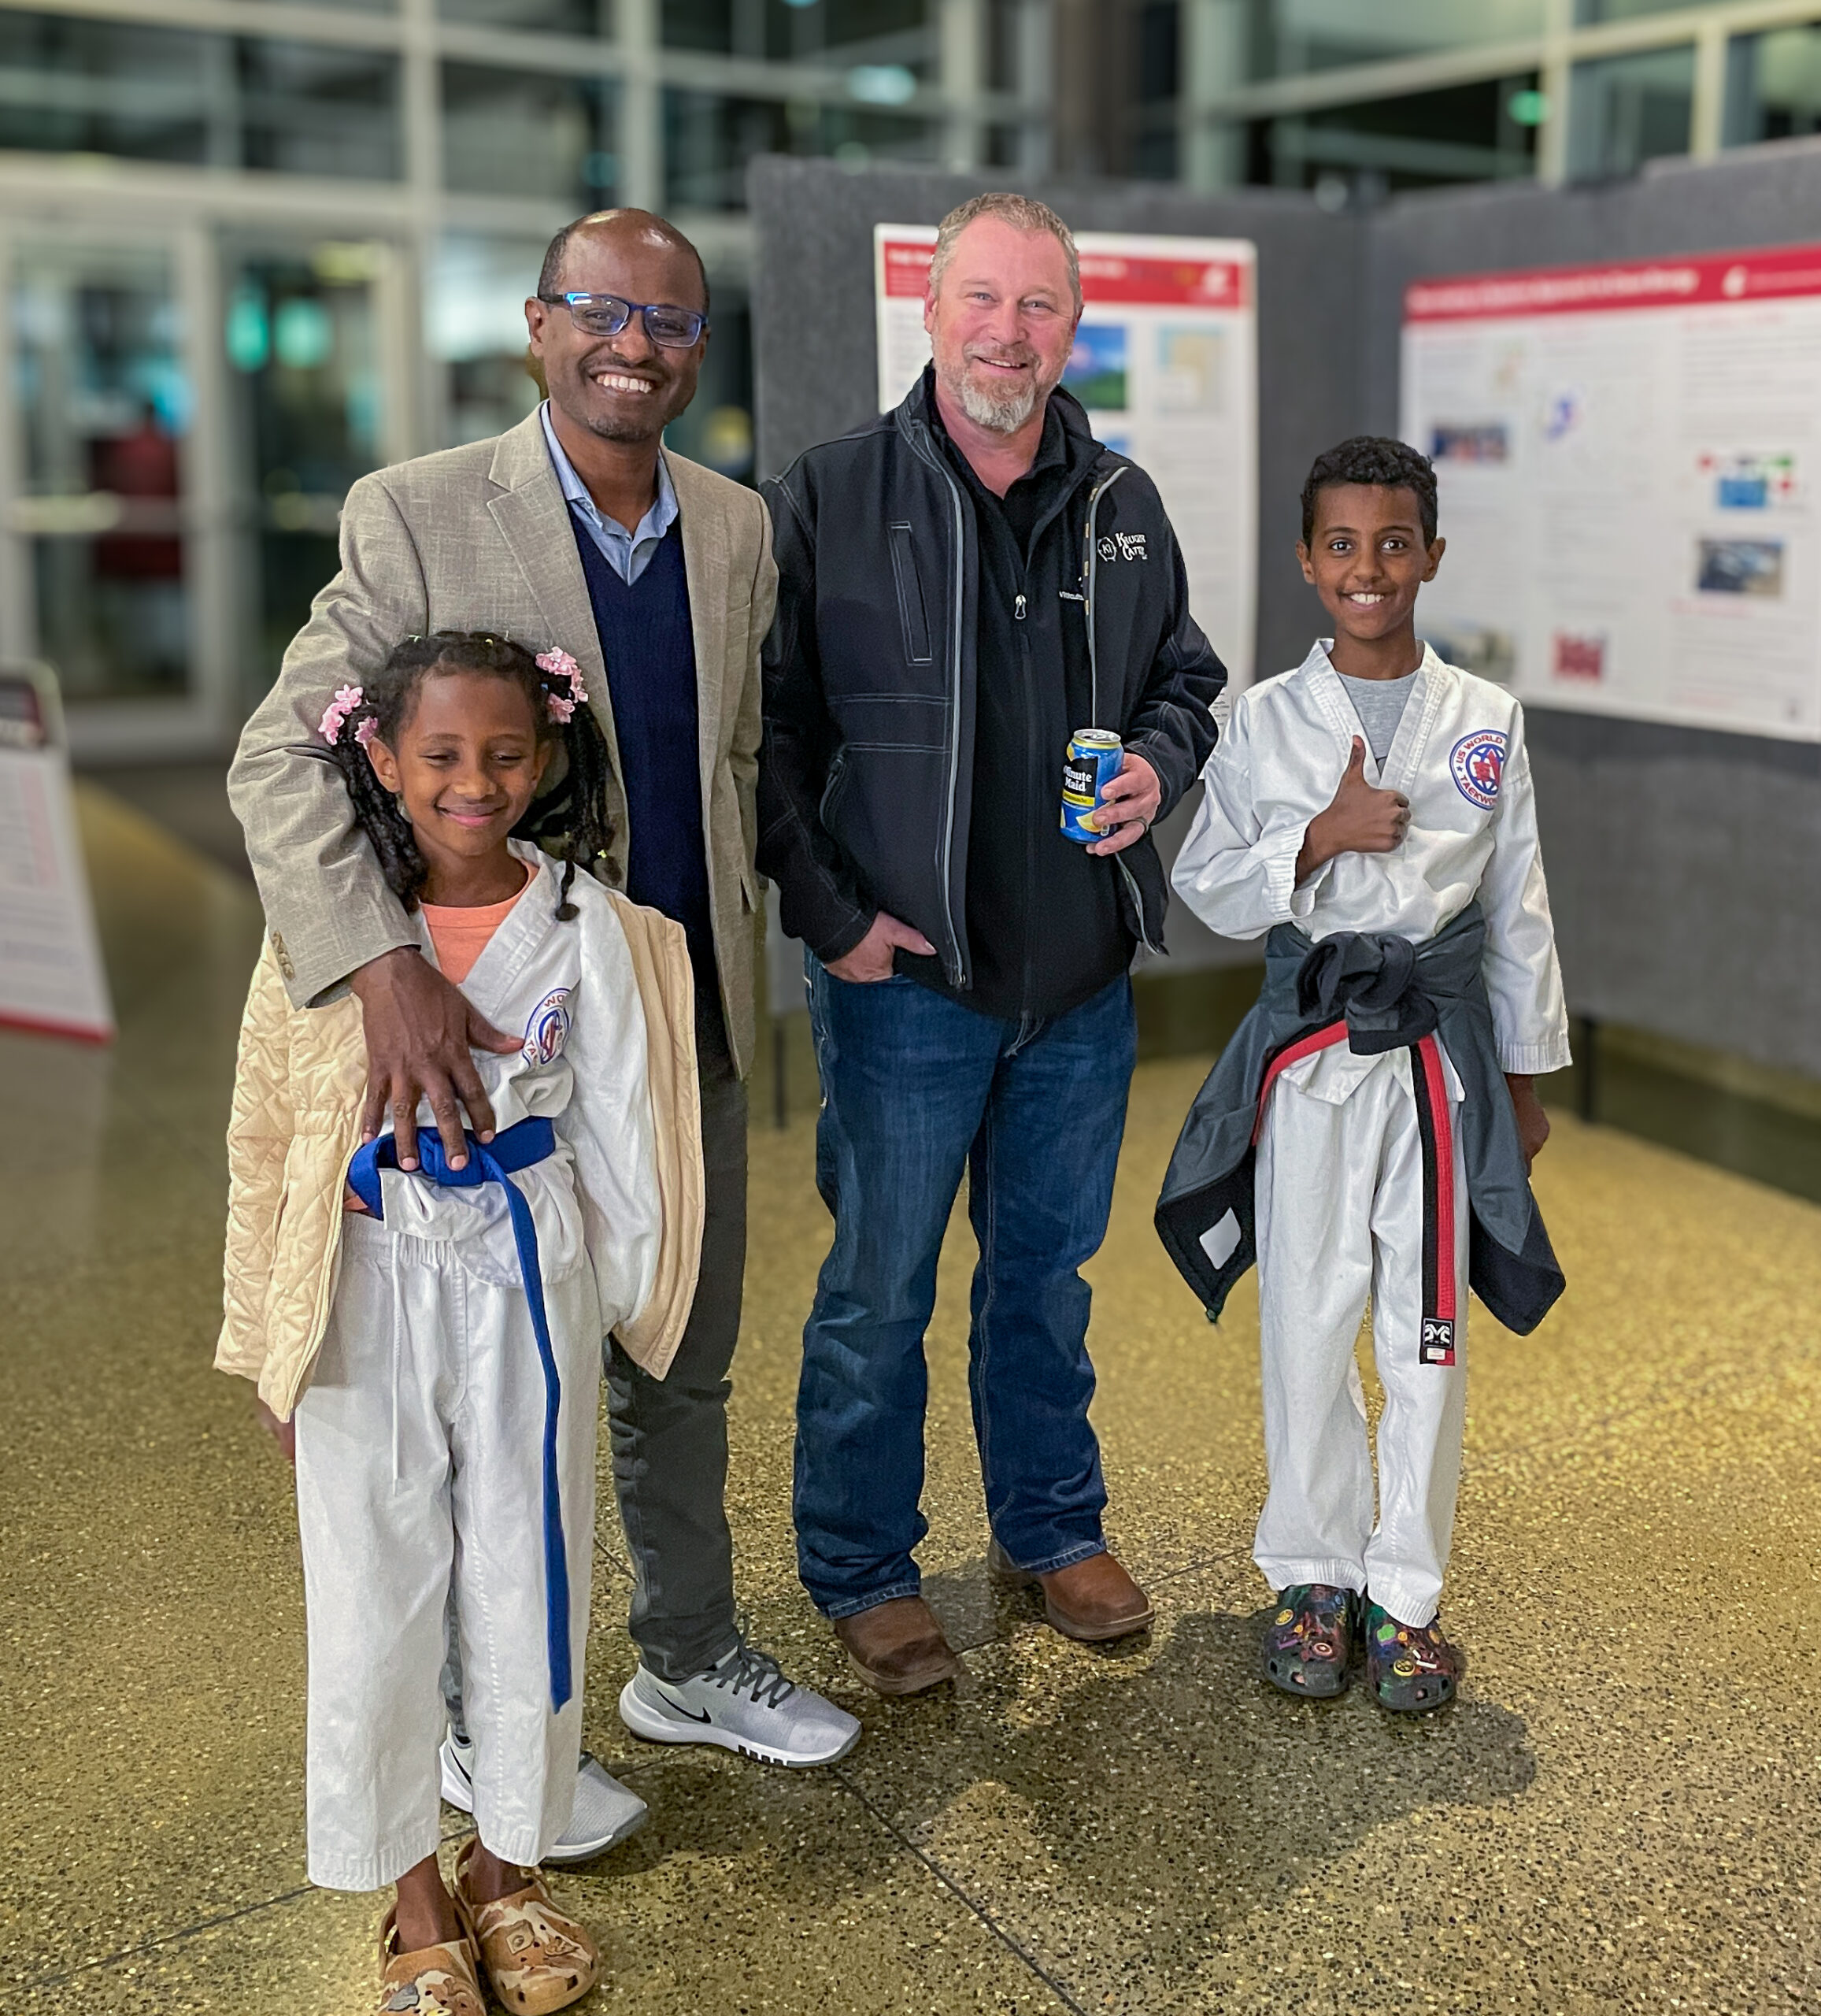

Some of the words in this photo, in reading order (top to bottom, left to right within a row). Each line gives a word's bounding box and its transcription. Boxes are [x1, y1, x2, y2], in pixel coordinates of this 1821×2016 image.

[1456, 750, 1466, 764] US
[1464, 735, 1503, 750] WORLD
[1064, 776, 1086, 792] Maid
